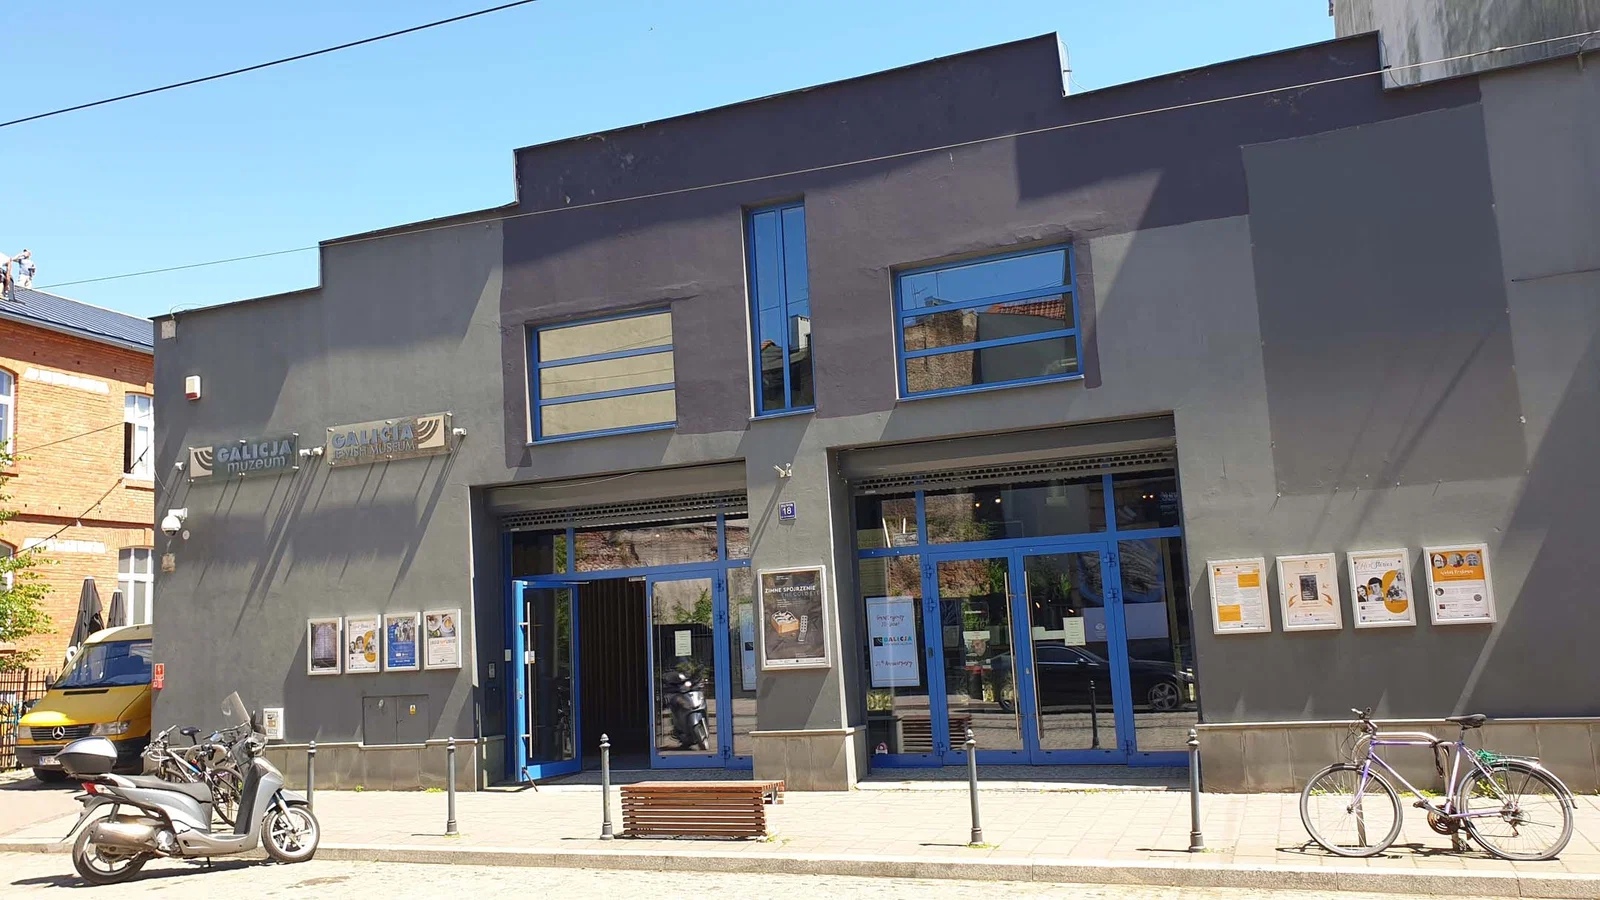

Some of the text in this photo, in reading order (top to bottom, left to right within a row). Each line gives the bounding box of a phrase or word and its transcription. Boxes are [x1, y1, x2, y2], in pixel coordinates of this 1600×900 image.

[332, 423, 414, 449] GALICIA
[217, 440, 292, 462] GALICJA
[371, 440, 416, 455] MUSEUM
[227, 455, 286, 473] muzeum
[783, 506, 792, 516] 18
